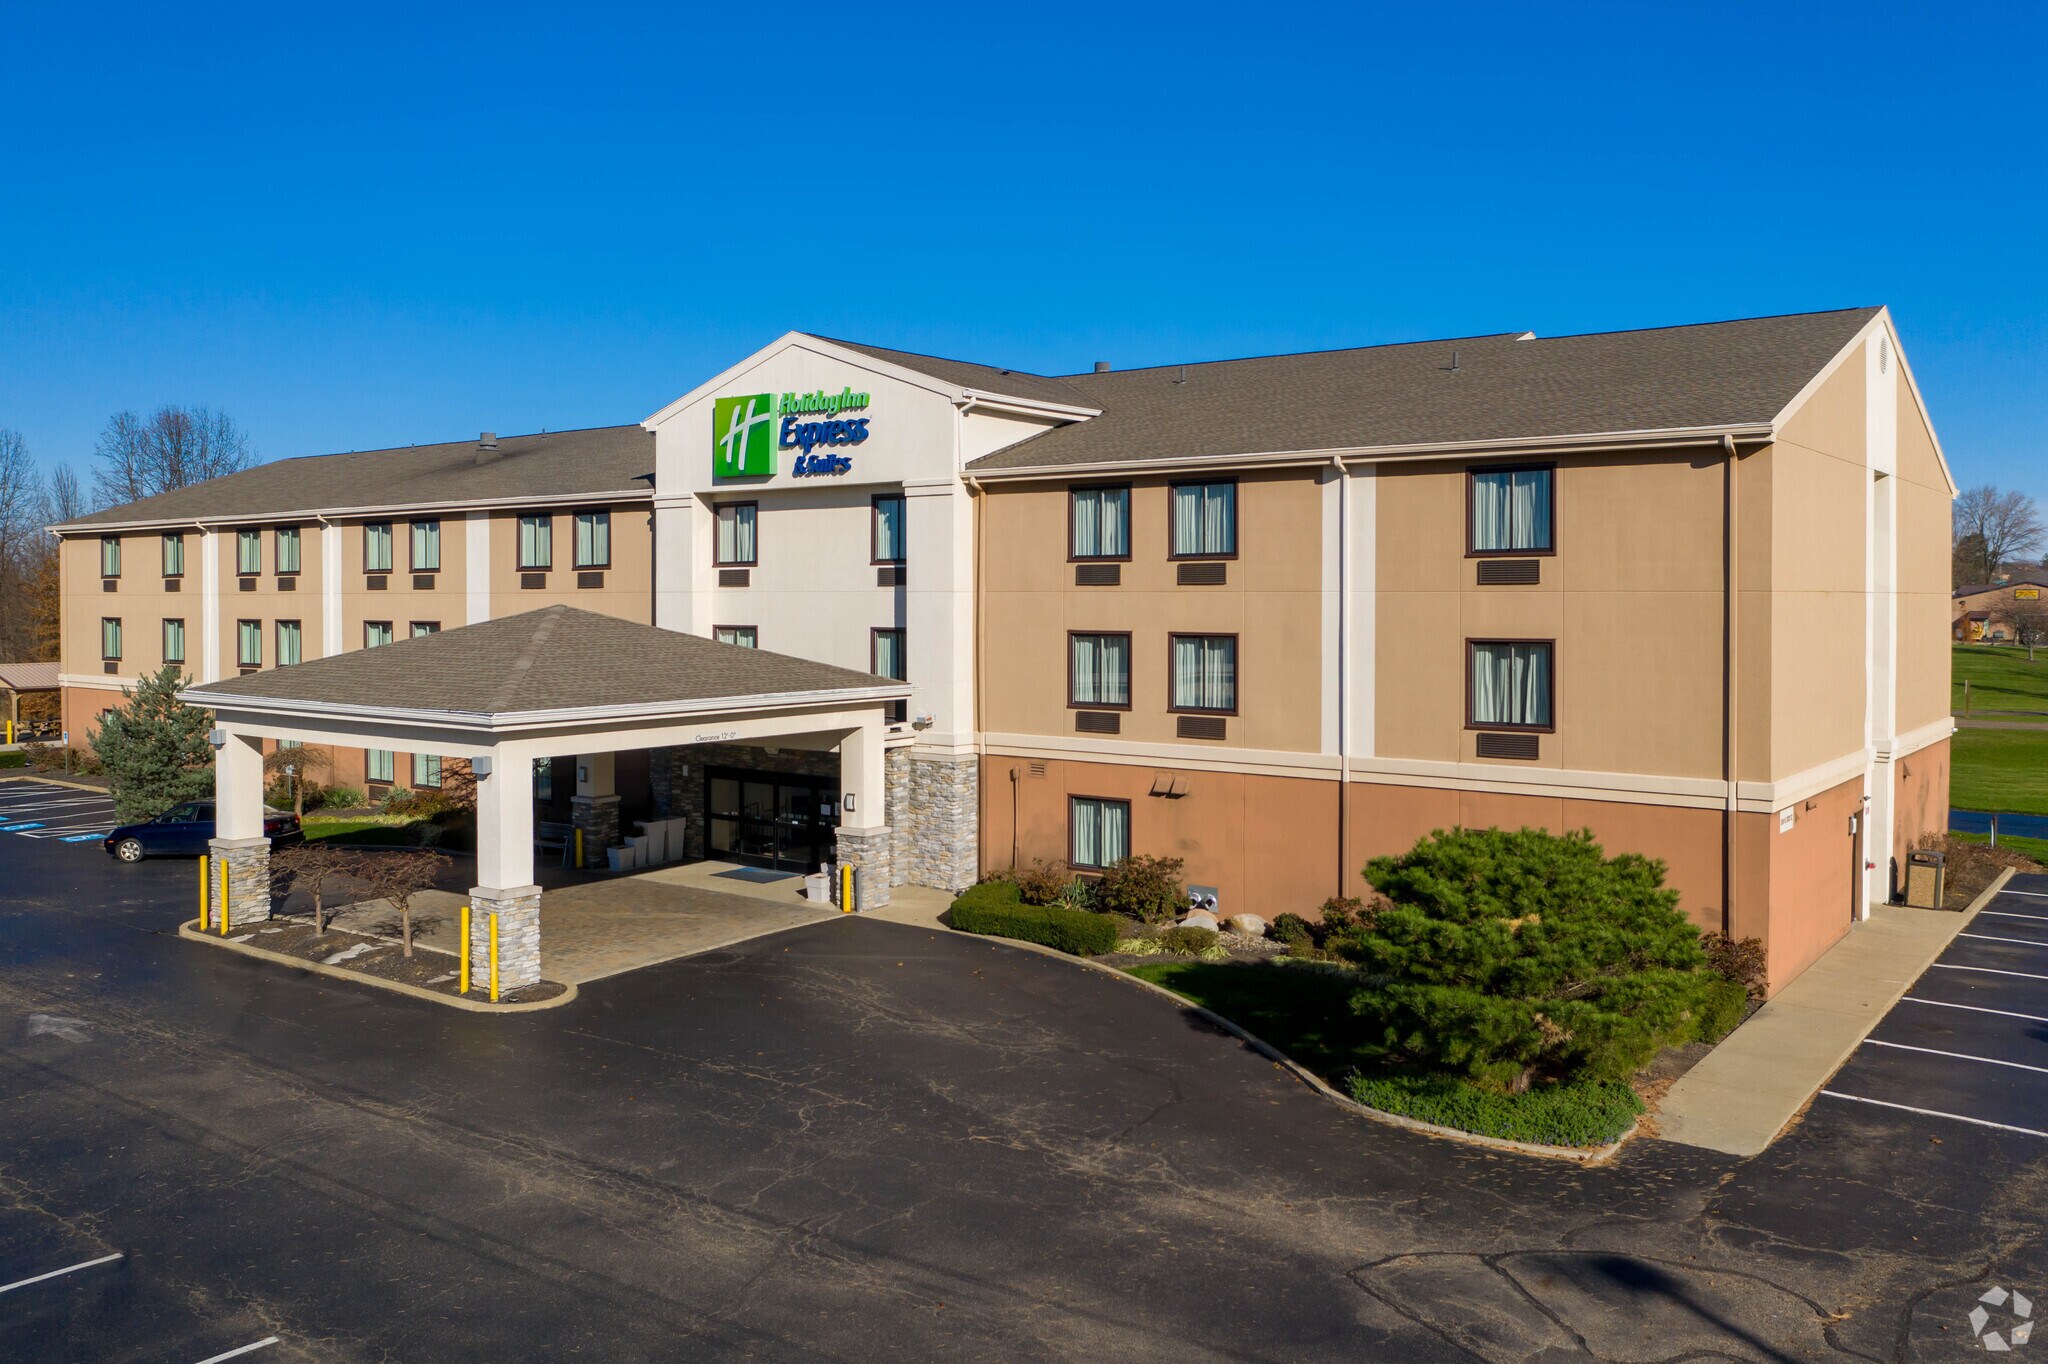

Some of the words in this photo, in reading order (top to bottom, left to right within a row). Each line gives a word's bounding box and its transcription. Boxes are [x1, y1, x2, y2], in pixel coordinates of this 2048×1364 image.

[780, 390, 841, 414] Holiday
[841, 386, 871, 408] Inn
[780, 416, 870, 453] Express
[794, 455, 807, 474] &
[807, 454, 852, 473] Suites
[695, 734, 720, 742] Clearance
